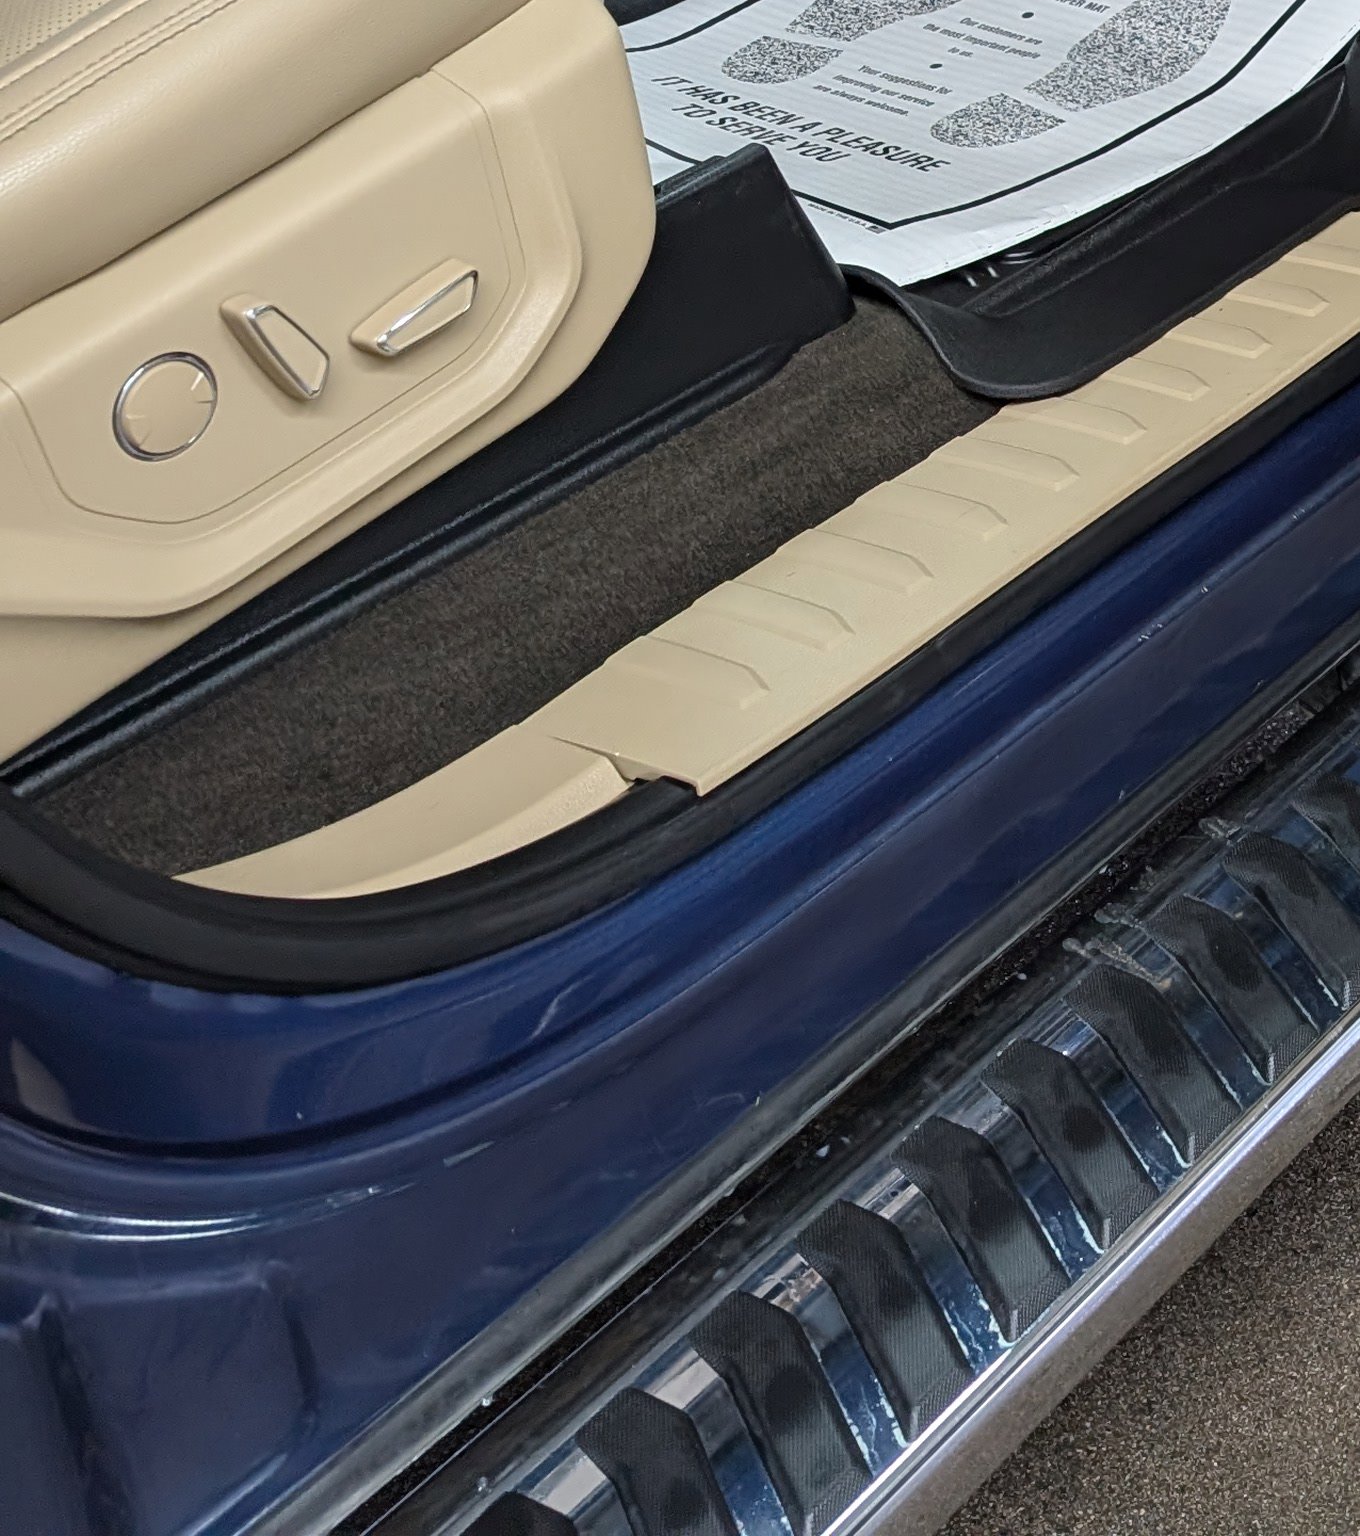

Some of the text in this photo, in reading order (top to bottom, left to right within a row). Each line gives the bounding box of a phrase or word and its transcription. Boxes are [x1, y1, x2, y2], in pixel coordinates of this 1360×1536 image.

[1084, 2, 1111, 13] MAT
[923, 23, 1041, 59] the most important people
[960, 17, 1043, 45] Our customers are
[858, 65, 952, 95] Your suggestions for
[830, 90, 866, 102] always
[880, 89, 900, 97] our
[898, 94, 935, 107] service
[651, 76, 951, 172] IT HAS BEEN A PLEASURE
[671, 103, 851, 162] TO SERVE YOU
